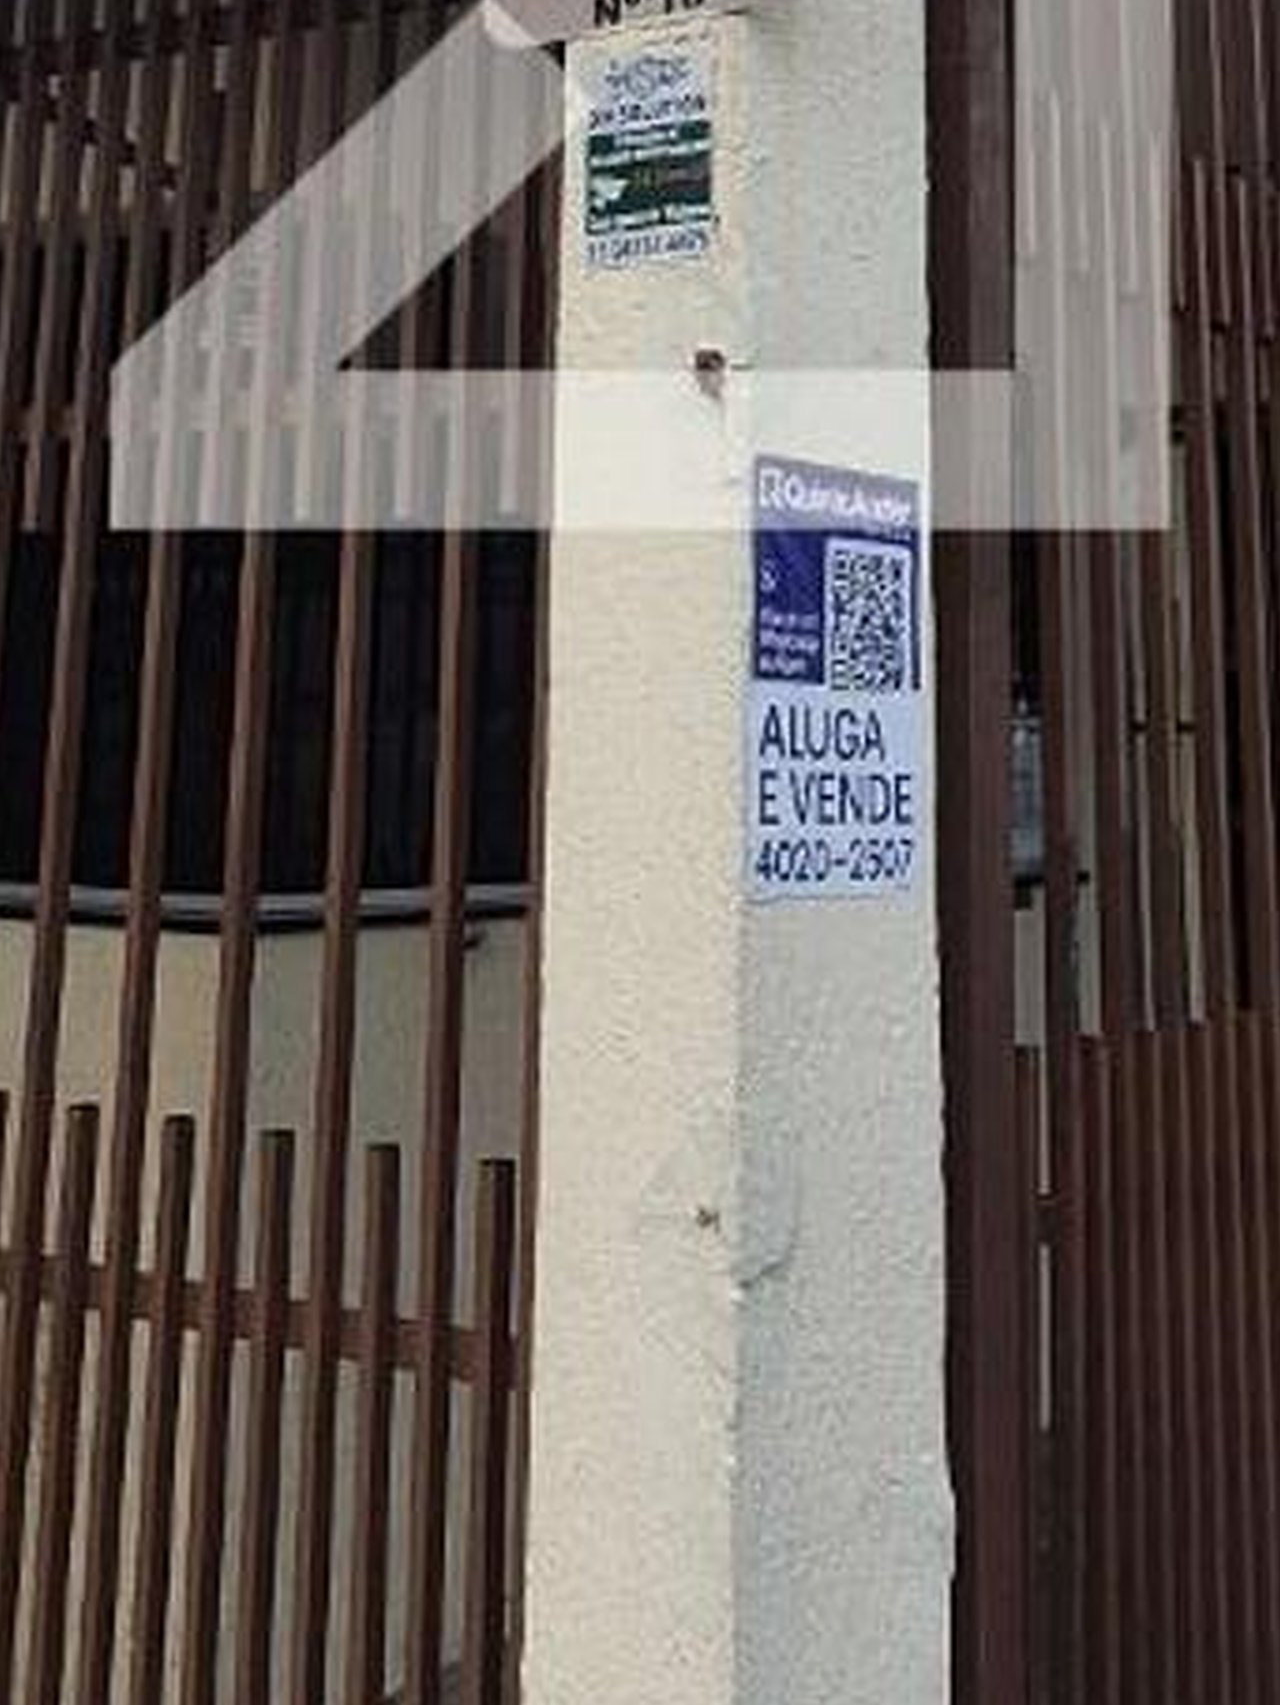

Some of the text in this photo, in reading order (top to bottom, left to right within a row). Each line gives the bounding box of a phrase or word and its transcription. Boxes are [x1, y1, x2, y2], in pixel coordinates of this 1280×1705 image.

[759, 704, 885, 761] ALUGA
[759, 769, 912, 826] E VENDE
